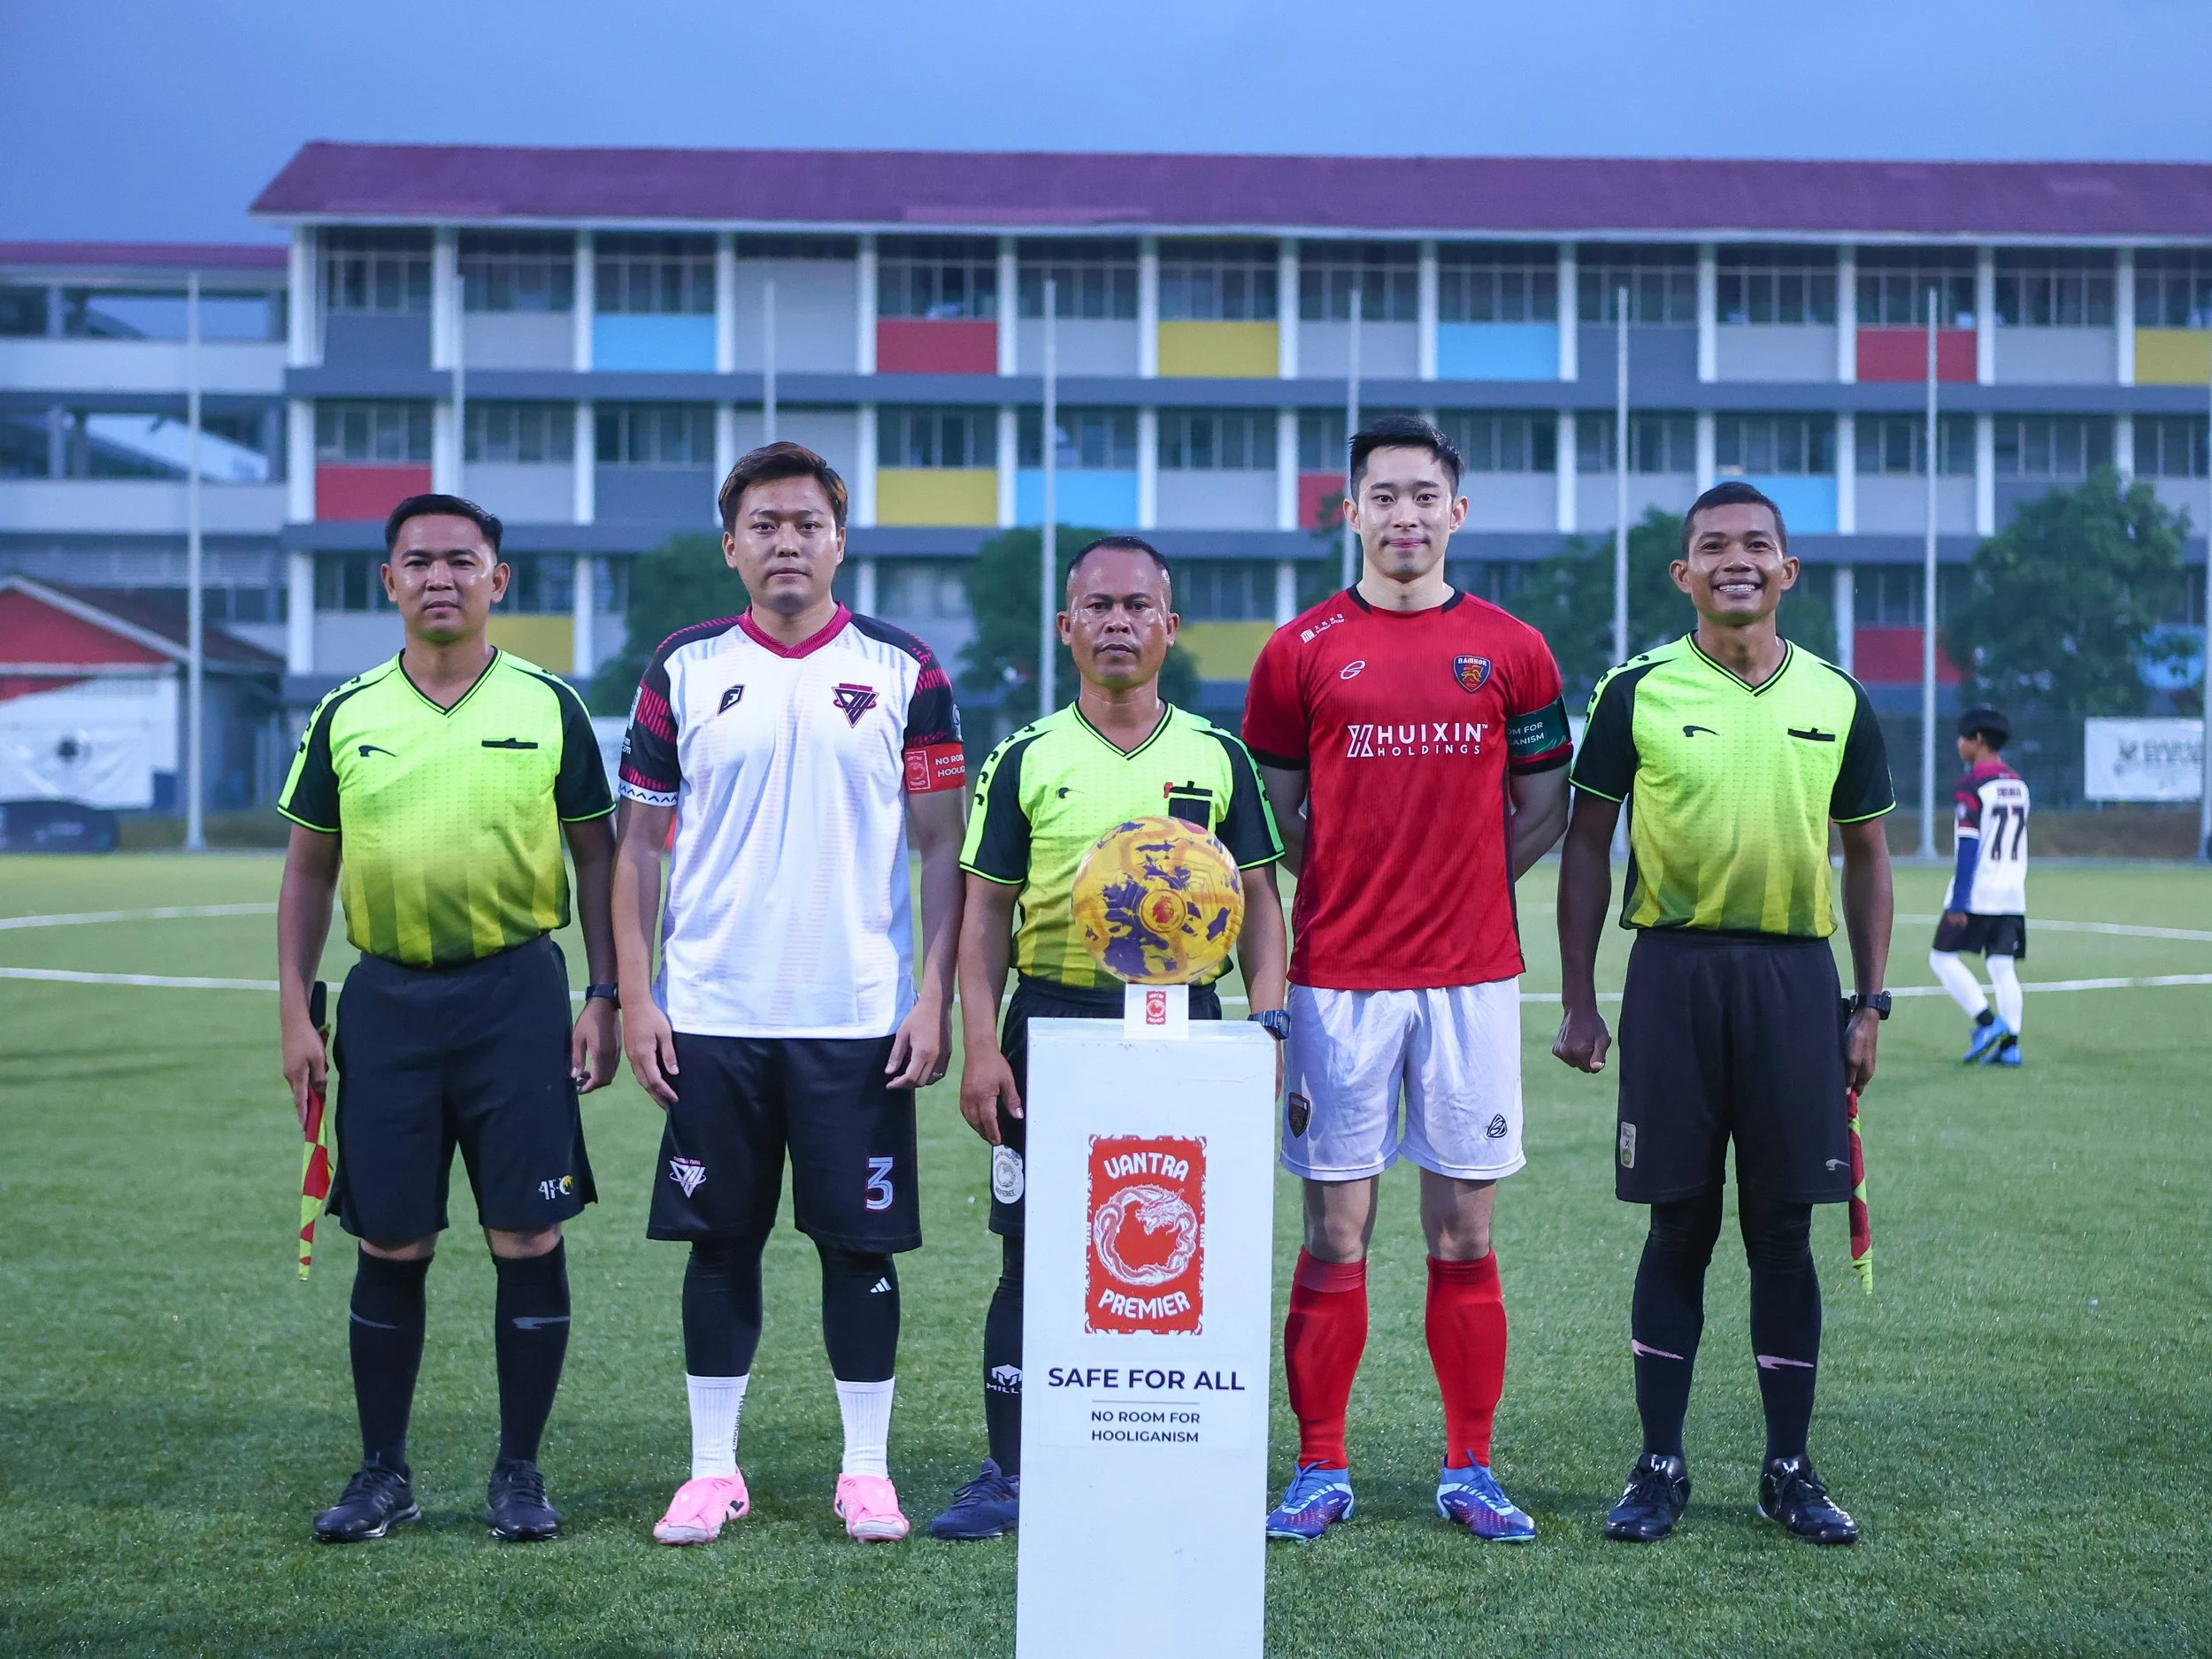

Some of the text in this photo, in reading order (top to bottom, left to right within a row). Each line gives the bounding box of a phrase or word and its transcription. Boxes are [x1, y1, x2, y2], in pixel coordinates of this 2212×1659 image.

[1377, 723, 1481, 745] HUIXIN
[1524, 721, 1543, 733] FOR
[934, 757, 949, 765] NO
[1378, 744, 1480, 757] HOLDINGS
[1991, 804, 2025, 862] 77
[1103, 1152, 1189, 1182] VANTRA
[865, 1156, 894, 1211] 3
[1098, 1288, 1192, 1319] PREMIER
[1048, 1367, 1246, 1391] SAFE FOR ALL
[1091, 1410, 1201, 1424] NO ROOM FOR
[1091, 1430, 1199, 1443] HOOLIGANISM
